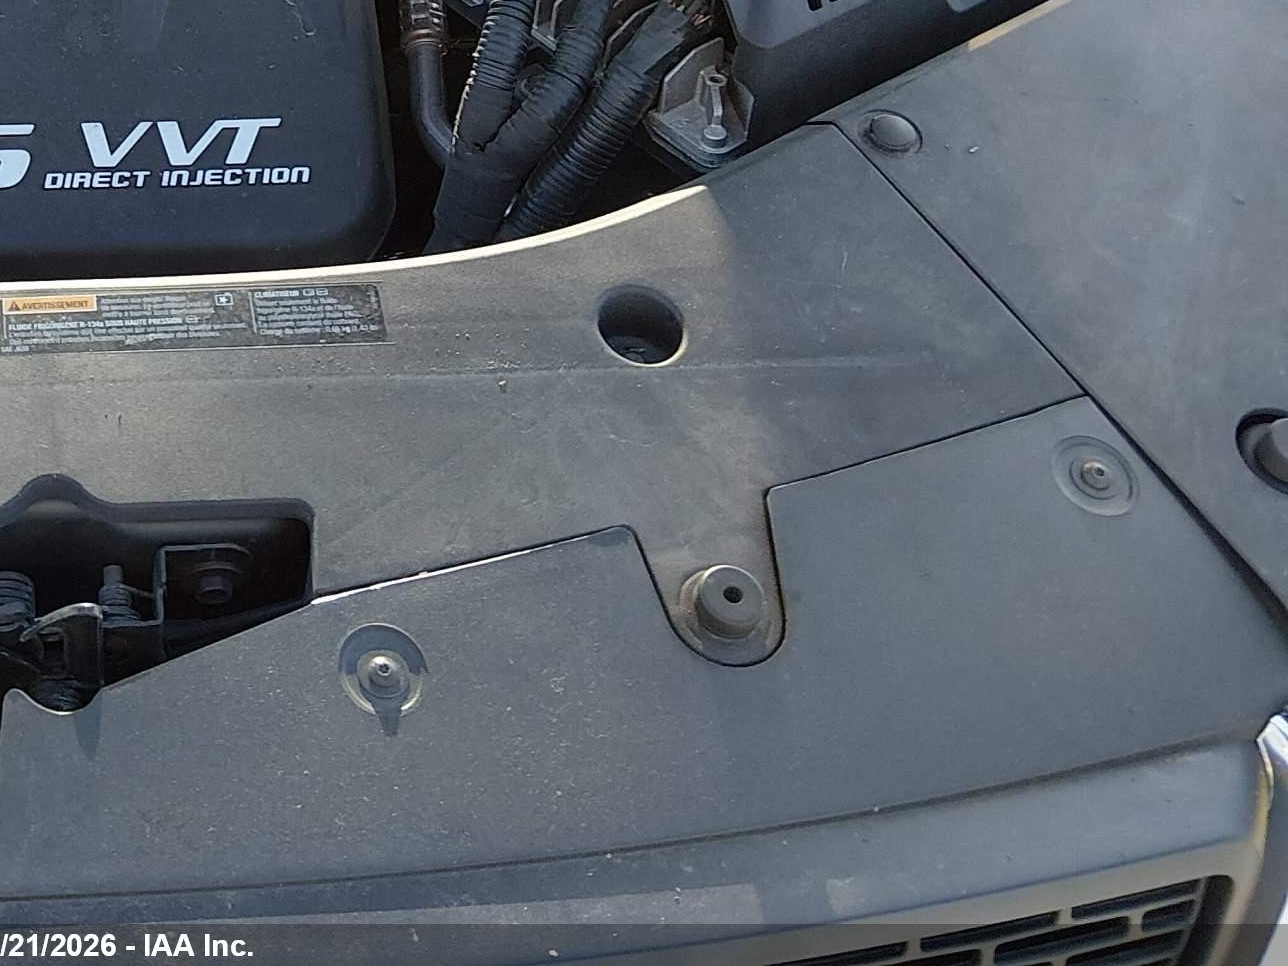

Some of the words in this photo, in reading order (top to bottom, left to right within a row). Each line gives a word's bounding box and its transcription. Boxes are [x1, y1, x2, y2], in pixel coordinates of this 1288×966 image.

[80, 117, 282, 167] VVT
[44, 170, 151, 189] DIRECT
[161, 166, 311, 186] INJECTION
